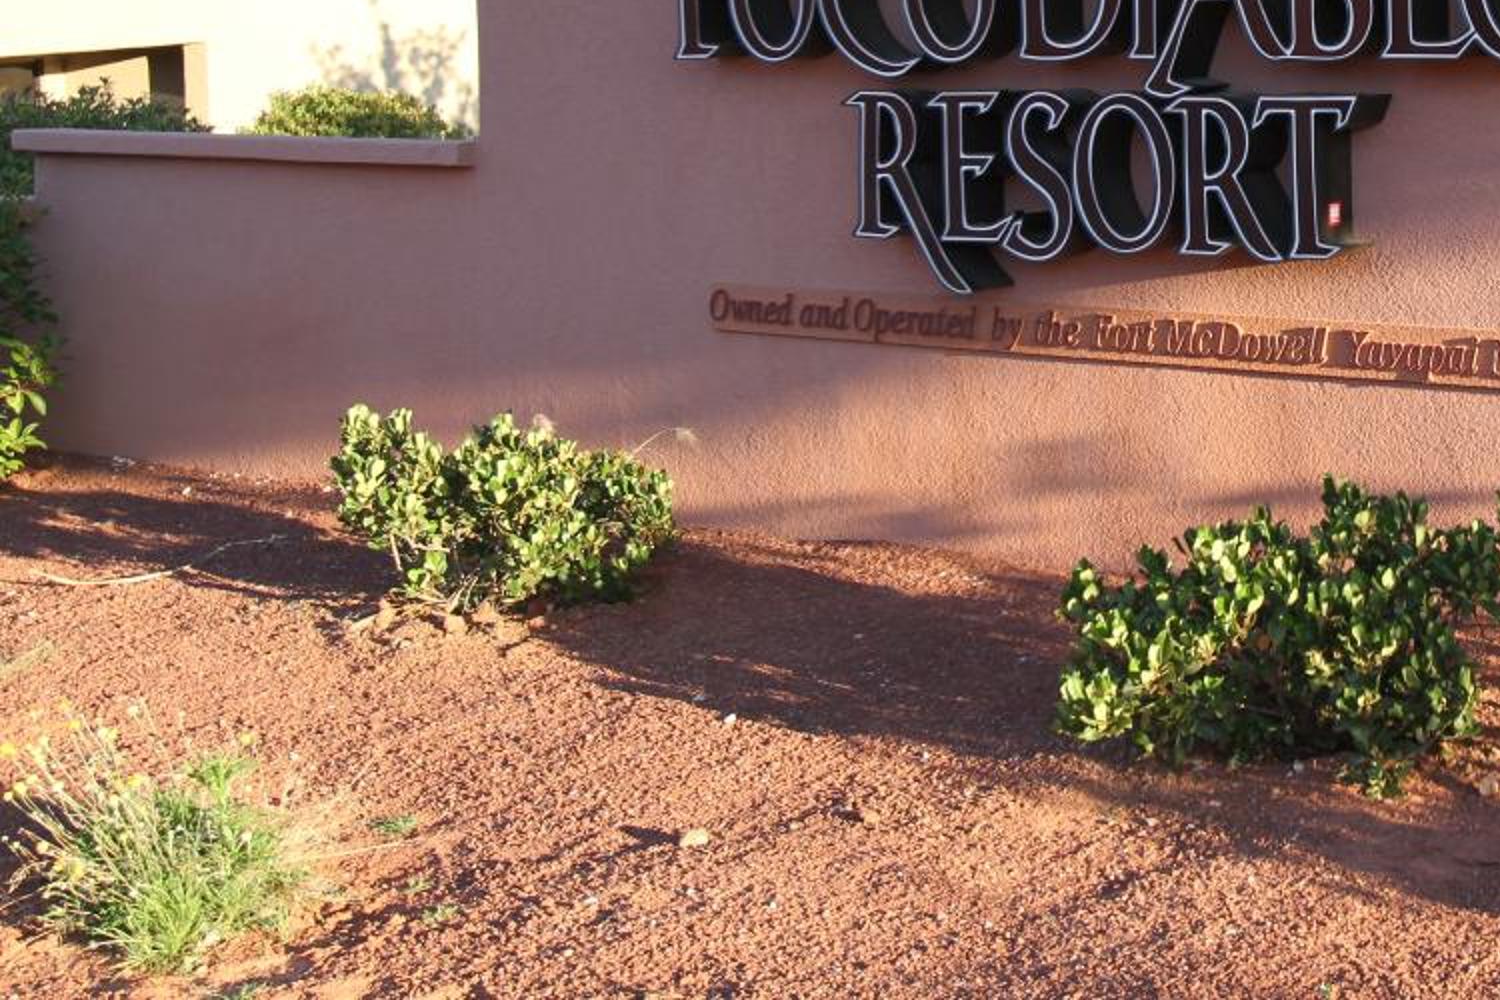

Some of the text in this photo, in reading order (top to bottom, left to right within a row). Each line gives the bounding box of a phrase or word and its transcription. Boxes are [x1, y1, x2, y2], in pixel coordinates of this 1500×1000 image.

[843, 90, 1356, 295] RESORT
[710, 289, 794, 326] Owned
[801, 298, 848, 332] and
[854, 298, 978, 342] Operated
[991, 306, 1024, 351] by
[1034, 310, 1082, 348] the
[1095, 314, 1157, 354] Fort
[1164, 319, 1326, 367] McDowell
